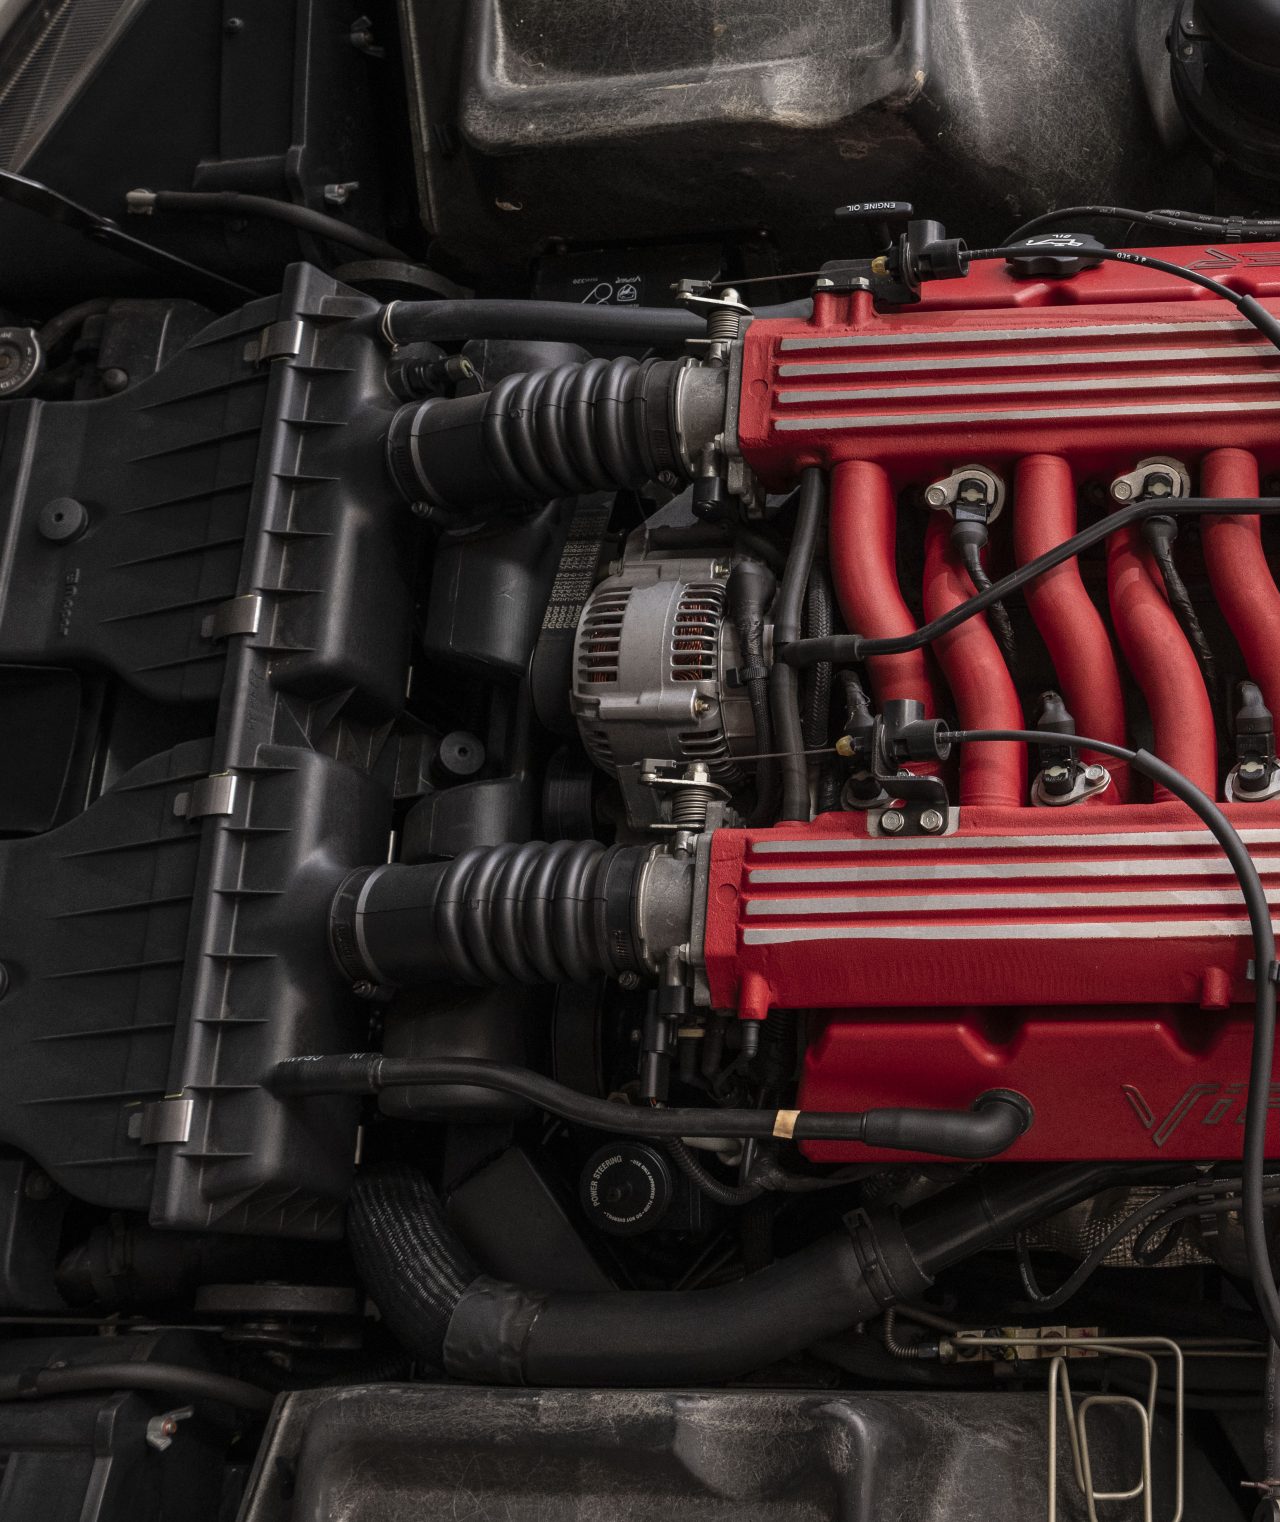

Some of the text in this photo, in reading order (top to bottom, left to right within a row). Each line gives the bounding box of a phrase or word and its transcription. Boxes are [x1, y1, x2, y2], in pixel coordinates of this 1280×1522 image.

[846, 202, 896, 211] ENGINE OIL
[590, 1154, 623, 1207] POWER STEERING
